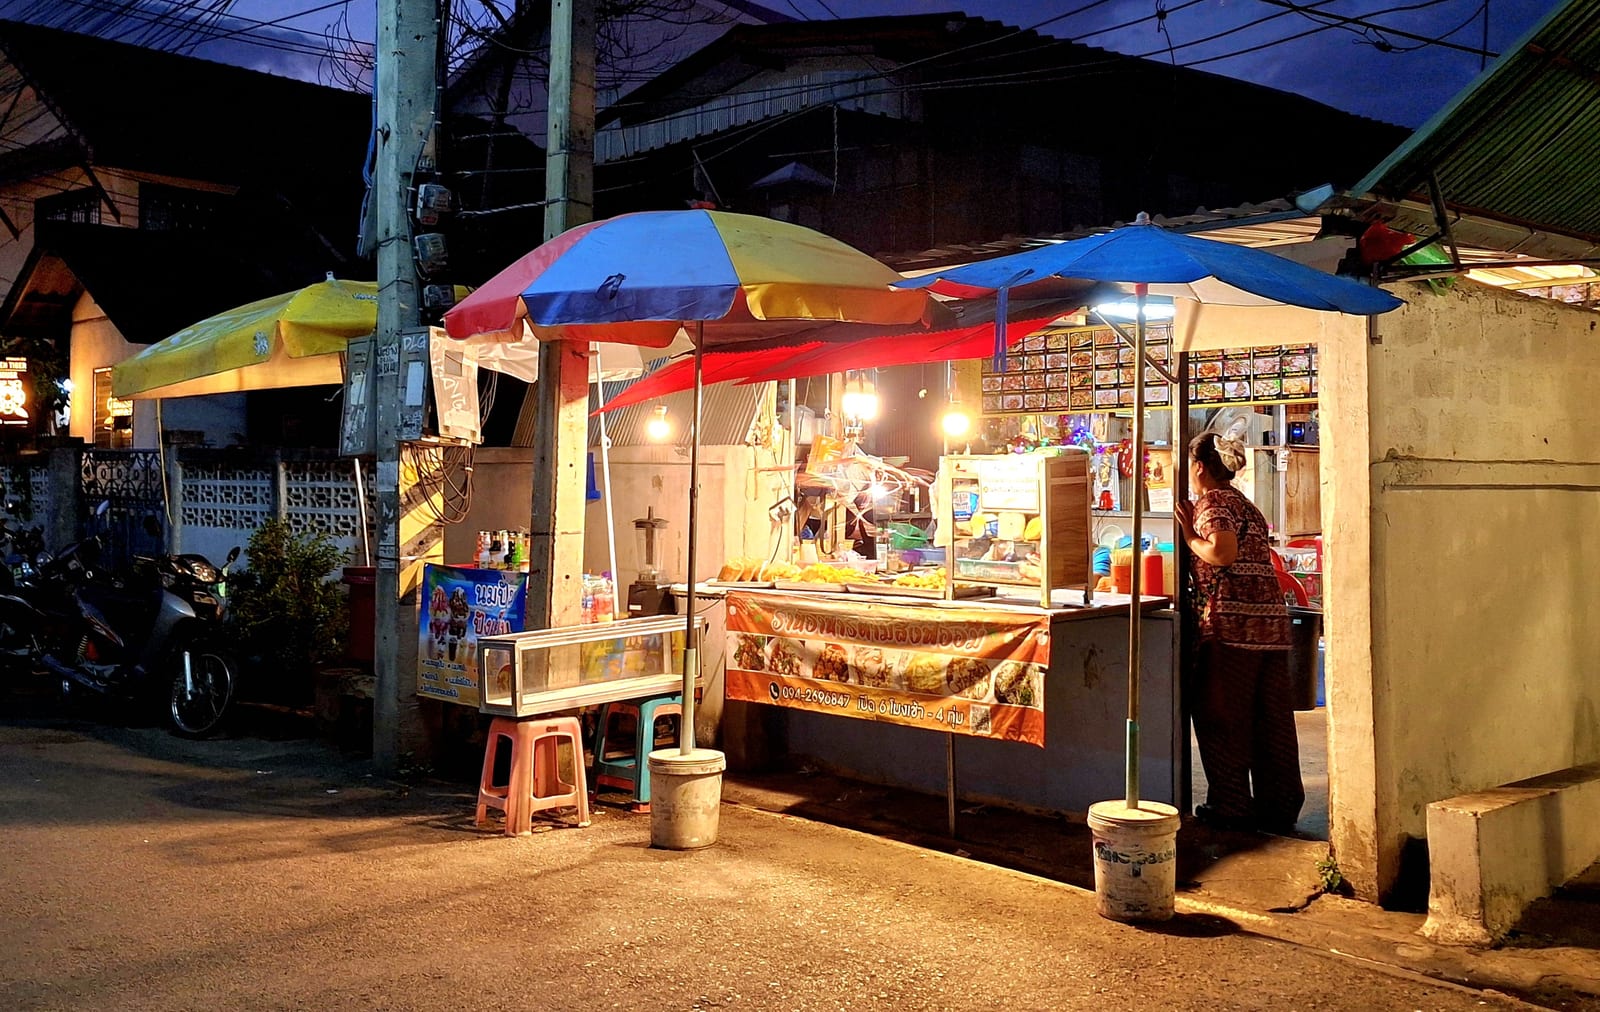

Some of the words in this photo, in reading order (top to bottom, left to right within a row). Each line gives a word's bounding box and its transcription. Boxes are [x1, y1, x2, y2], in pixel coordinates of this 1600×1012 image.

[782, 686, 851, 709] 094-2696847
[857, 694, 875, 712] เปิด
[879, 700, 888, 714] 6
[889, 698, 925, 719] โมงเช้า
[935, 707, 945, 722] 4
